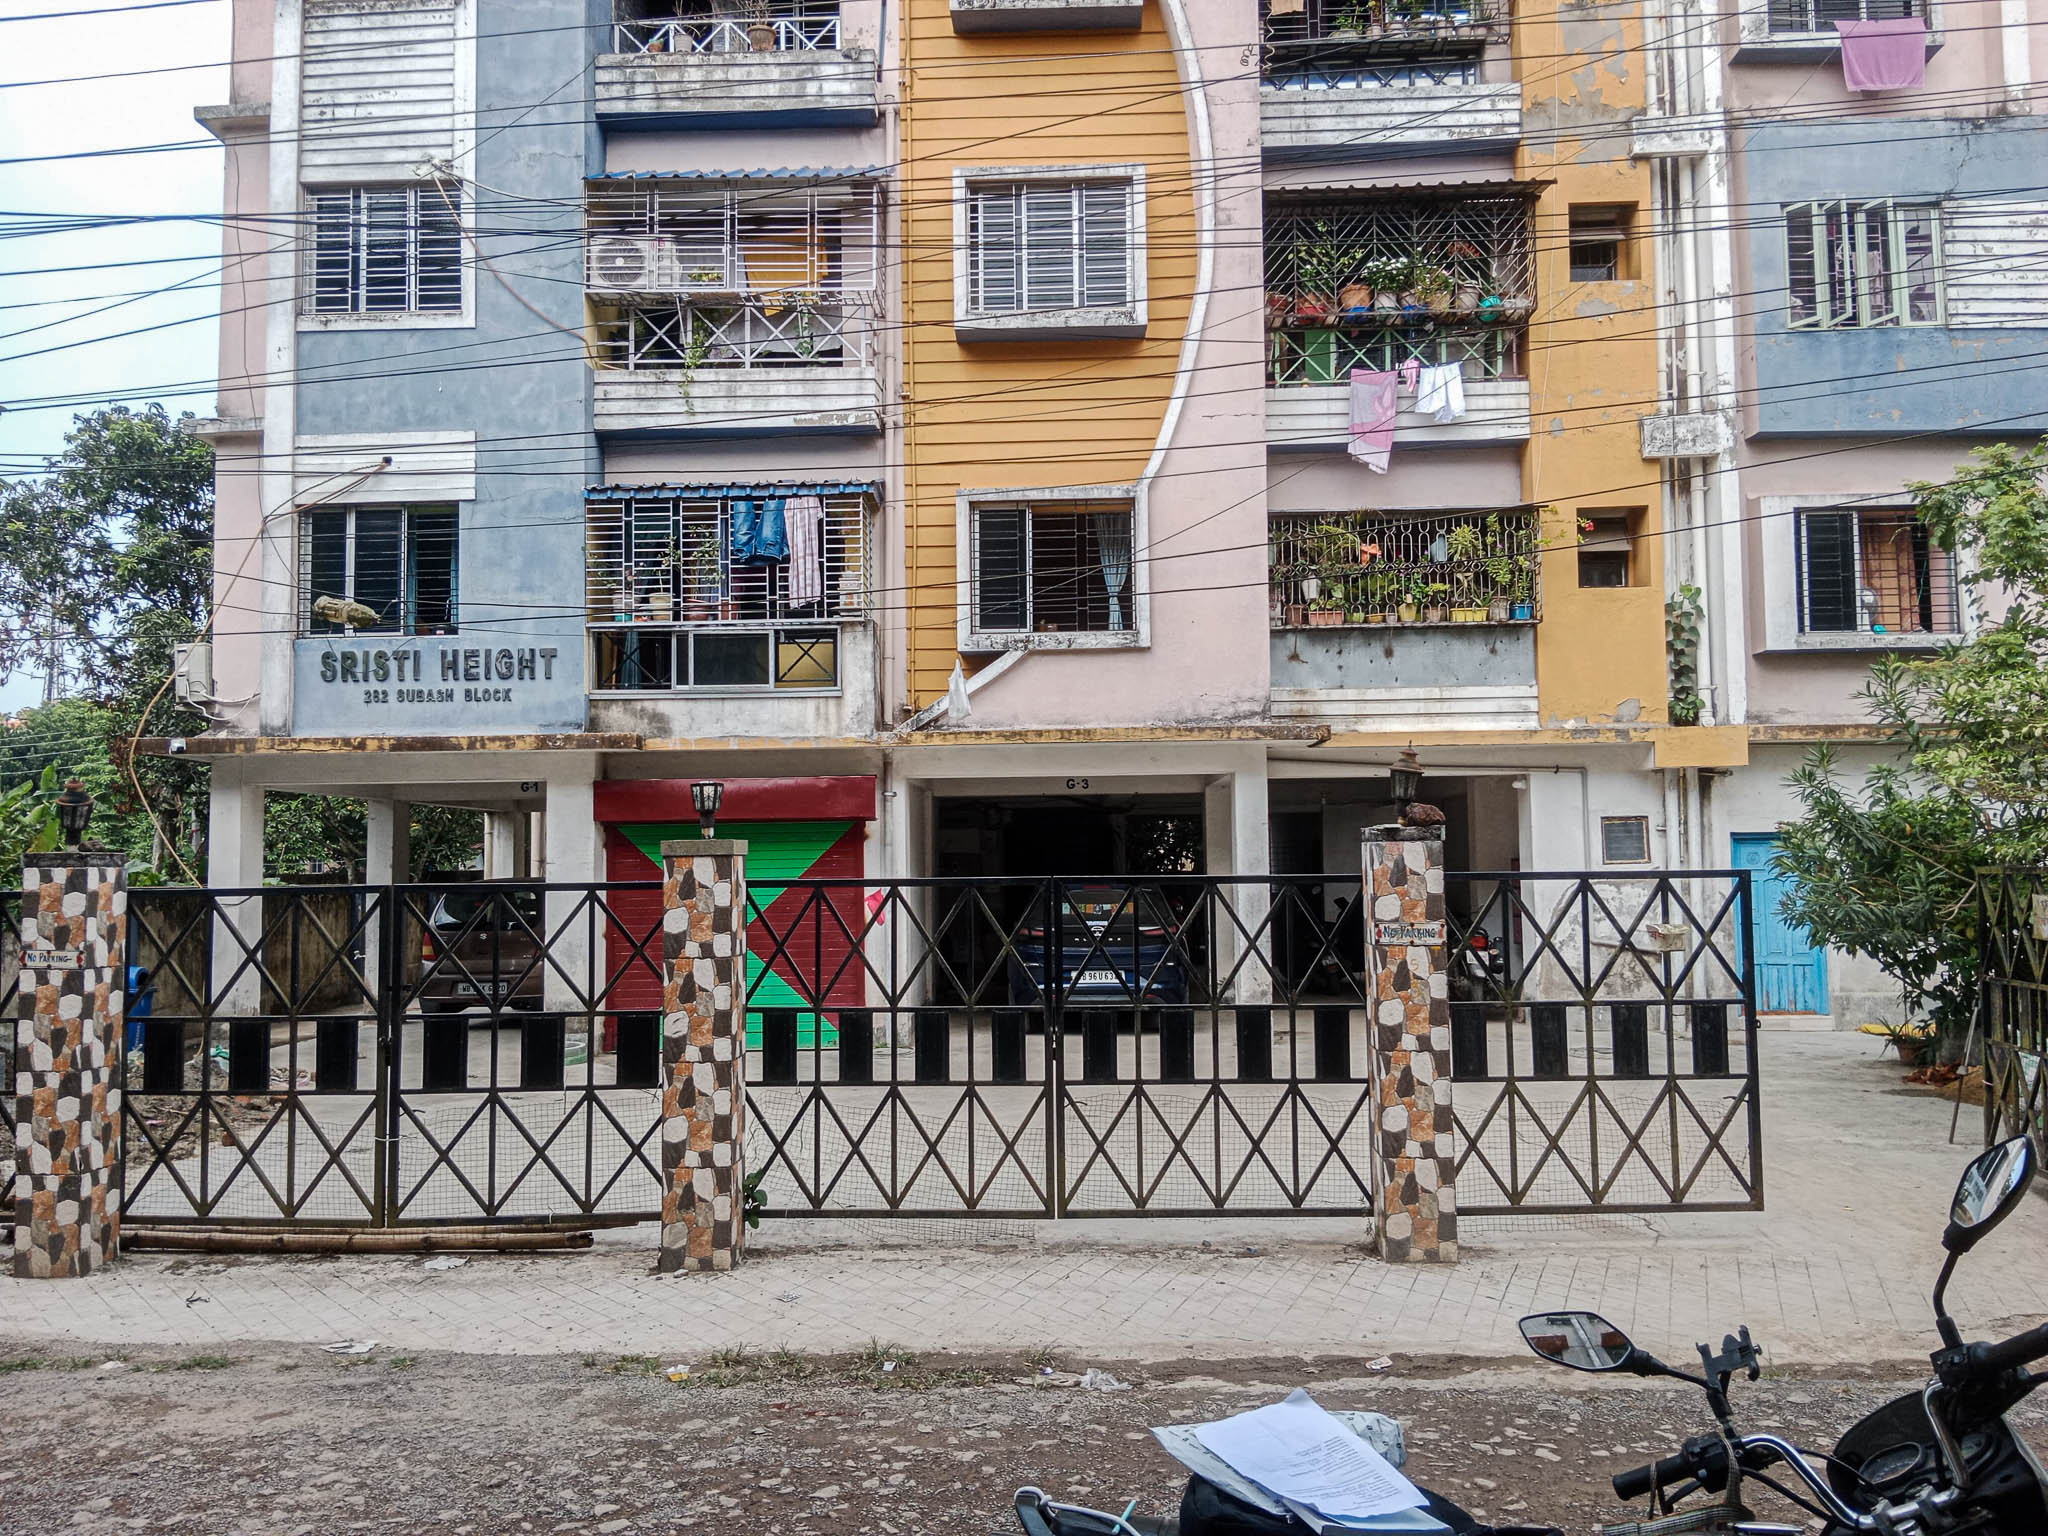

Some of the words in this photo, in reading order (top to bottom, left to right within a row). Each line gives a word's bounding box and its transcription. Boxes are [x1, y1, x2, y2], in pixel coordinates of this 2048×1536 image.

[320, 650, 421, 683] SRISTI
[441, 648, 558, 681] HEIGHT
[396, 688, 454, 703] SUBASH
[464, 687, 512, 702] BLOCK
[521, 781, 538, 792] G-1
[1066, 778, 1089, 789] G-3
